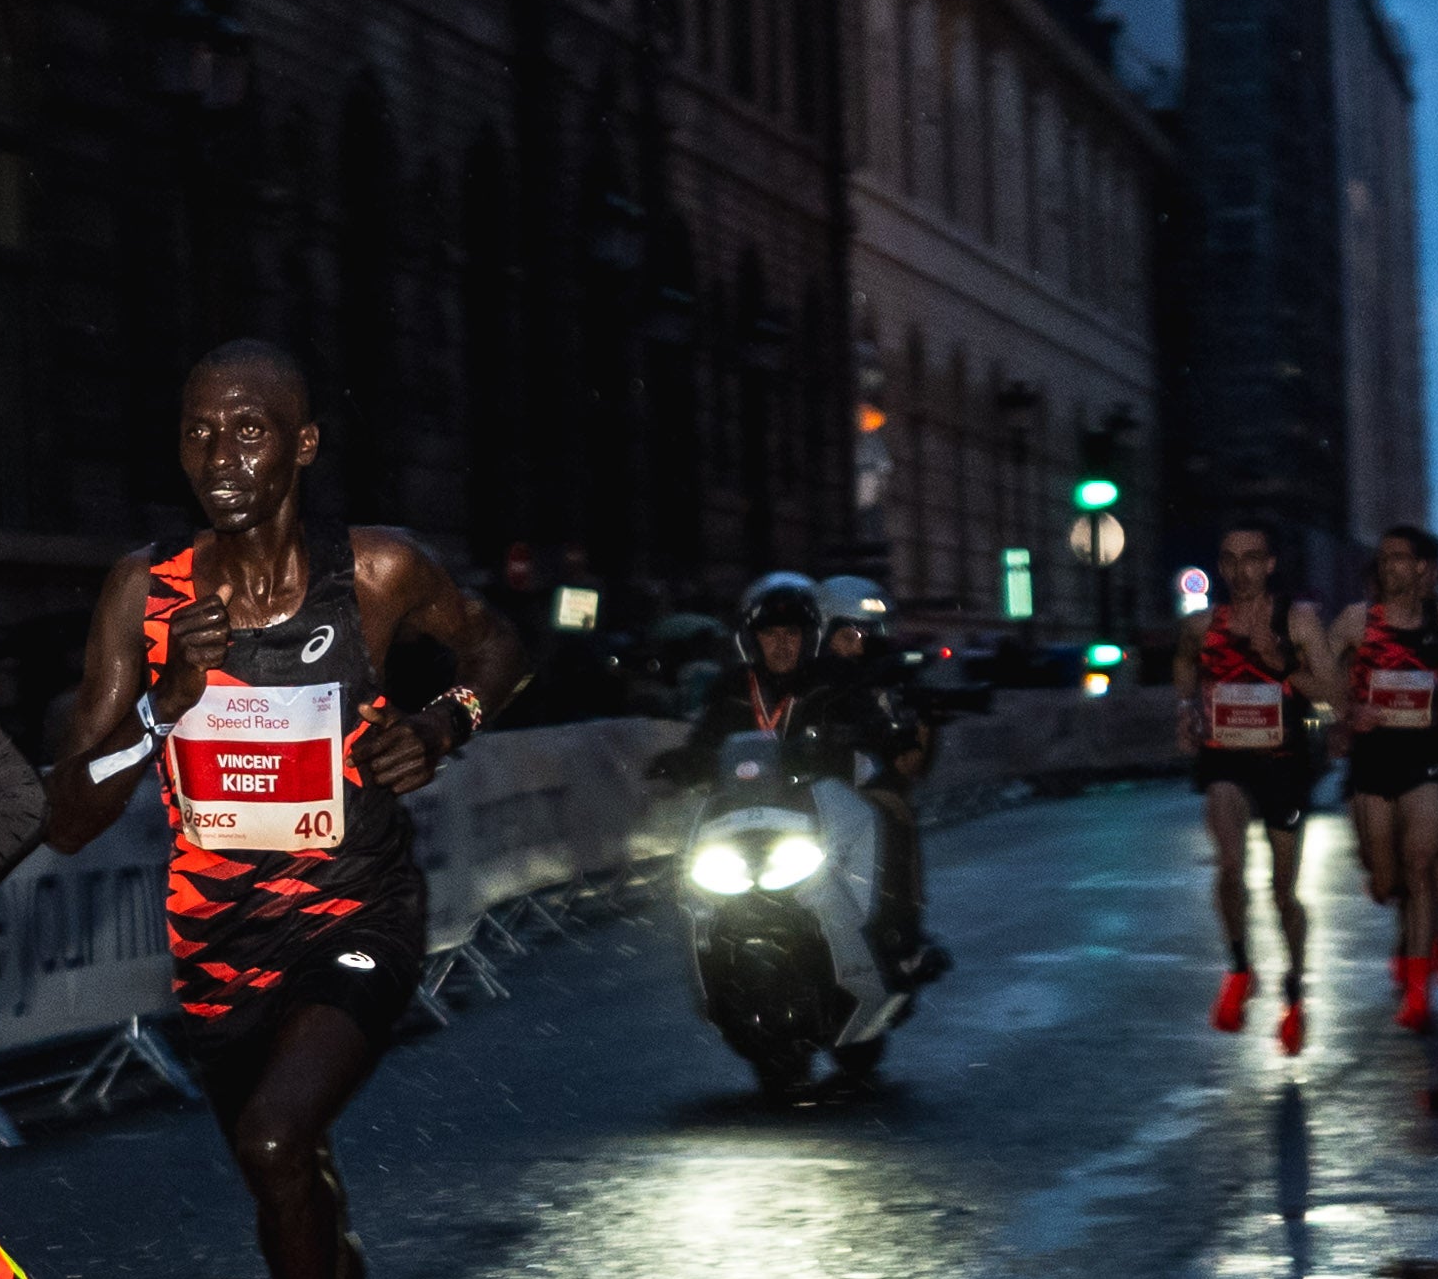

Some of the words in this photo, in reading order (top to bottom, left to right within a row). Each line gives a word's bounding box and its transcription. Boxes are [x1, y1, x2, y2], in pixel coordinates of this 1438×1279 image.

[226, 698, 270, 713] ASICS
[207, 714, 252, 732] Speed
[255, 715, 290, 729] Race
[217, 754, 282, 770] VINCENT
[222, 773, 278, 793] KIBET
[294, 810, 333, 839] 40
